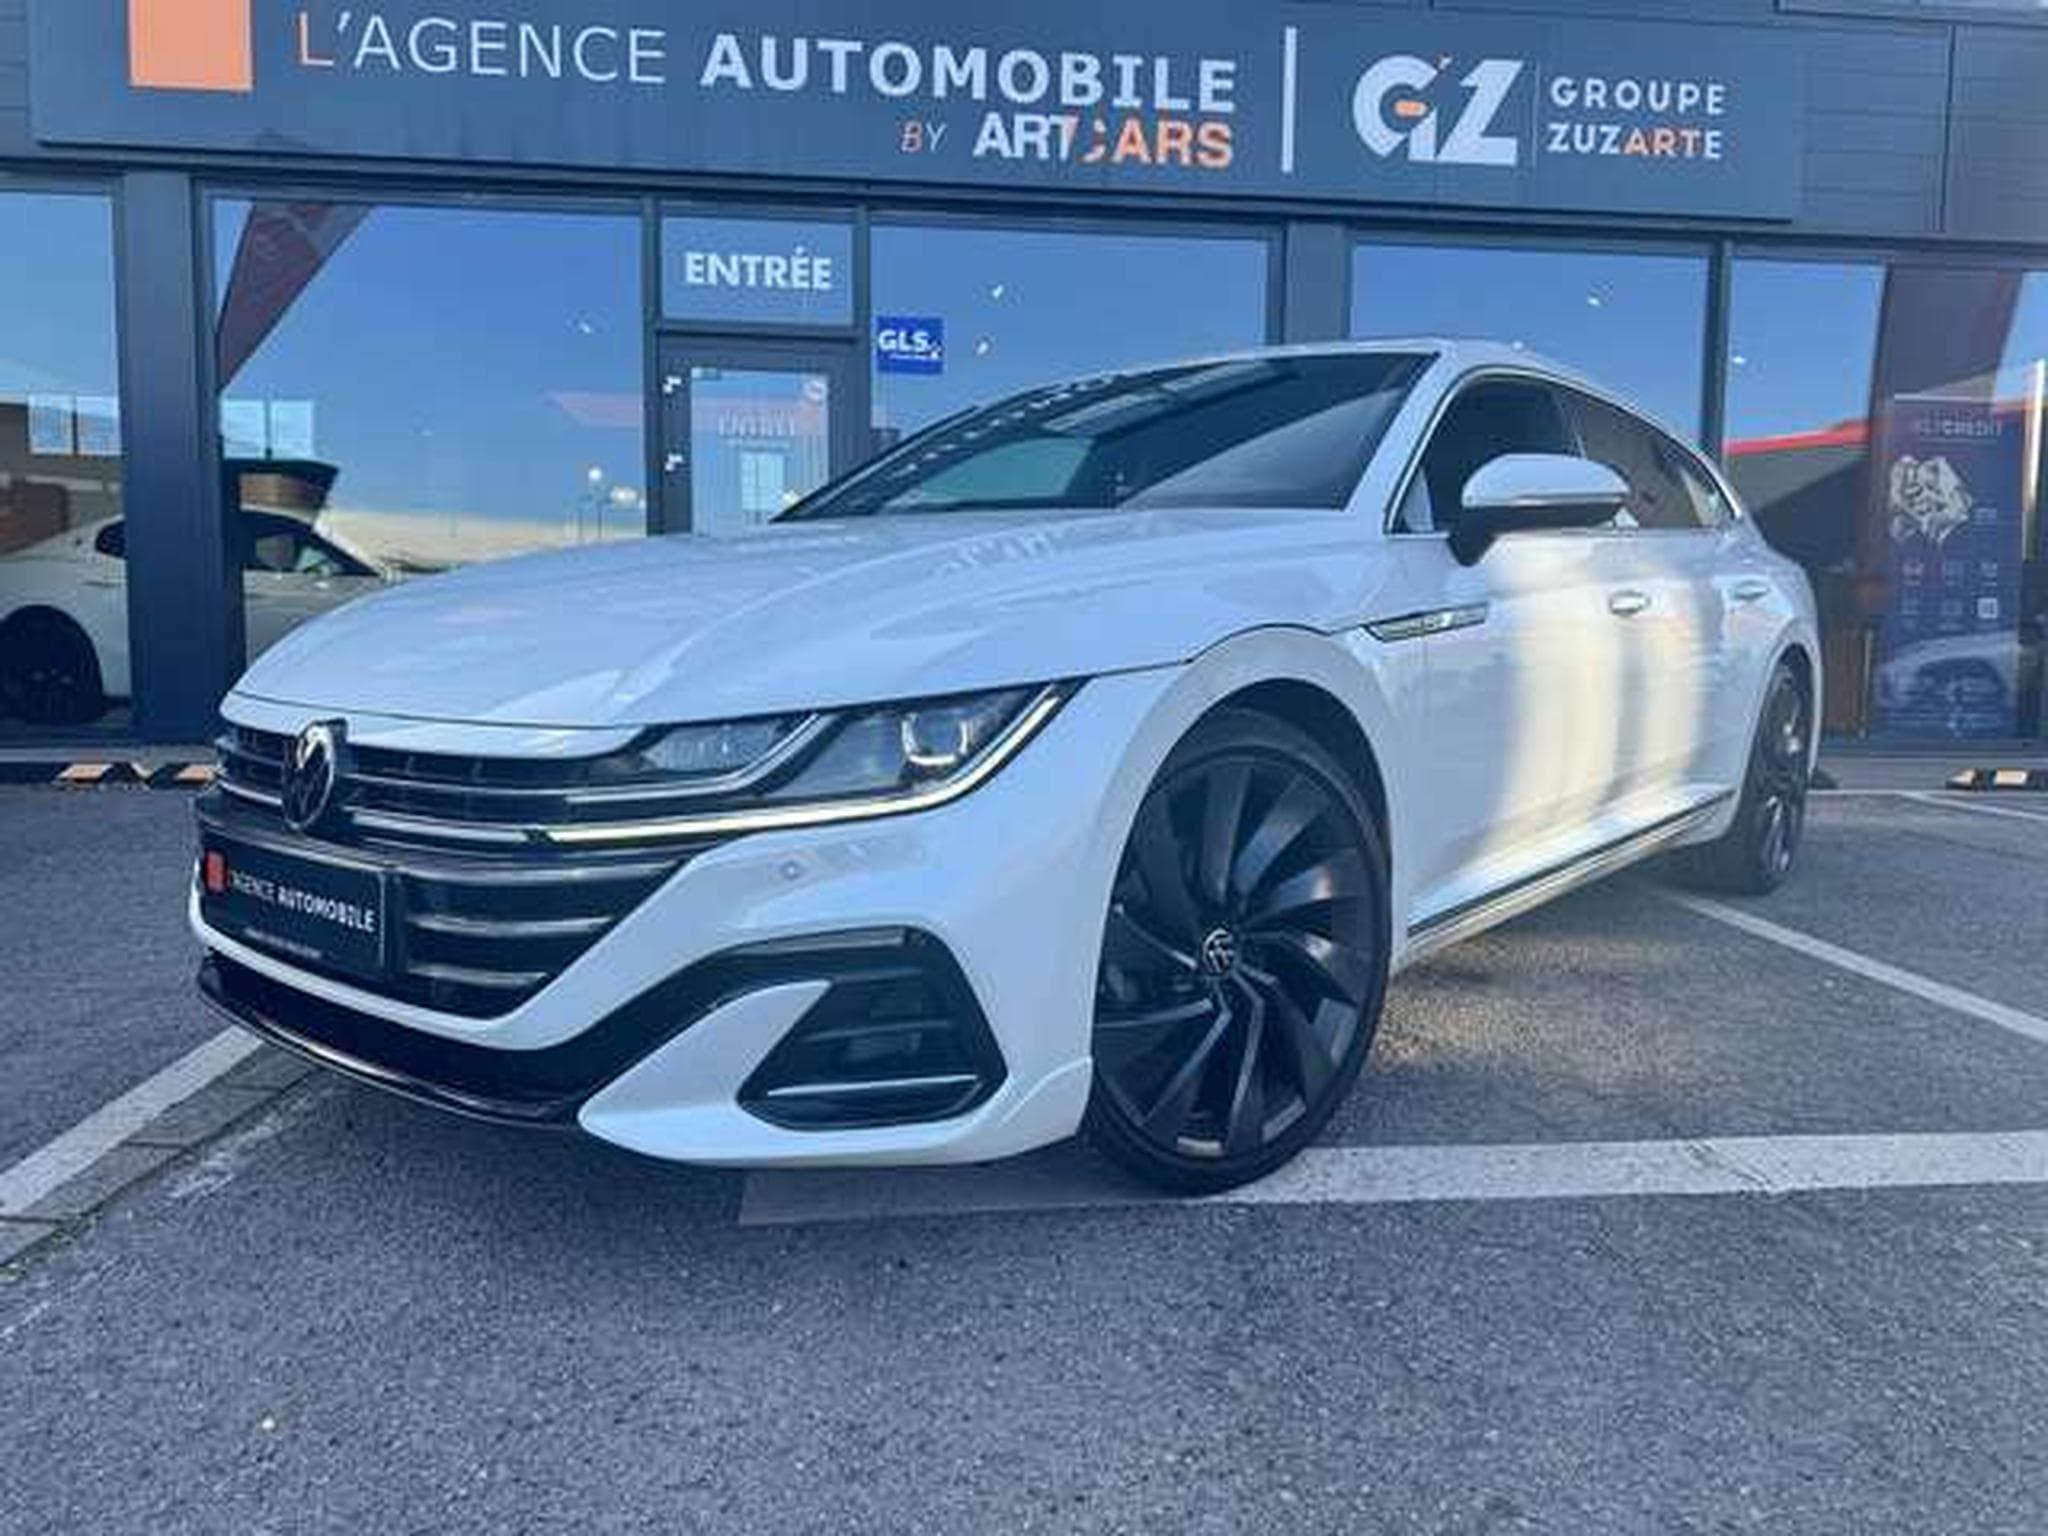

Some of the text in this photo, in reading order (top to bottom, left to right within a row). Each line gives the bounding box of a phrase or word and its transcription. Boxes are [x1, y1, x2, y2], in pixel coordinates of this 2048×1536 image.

[297, 11, 1238, 114] L'AGENCE AUTOMOBILE
[1550, 76, 1727, 115] GROUPE
[900, 121, 946, 152] BY
[1547, 122, 1724, 160] ZUZARTE
[684, 245, 833, 290] ENTRÉE
[879, 328, 928, 352] GLS
[277, 885, 377, 934] AUTOMOBILE
